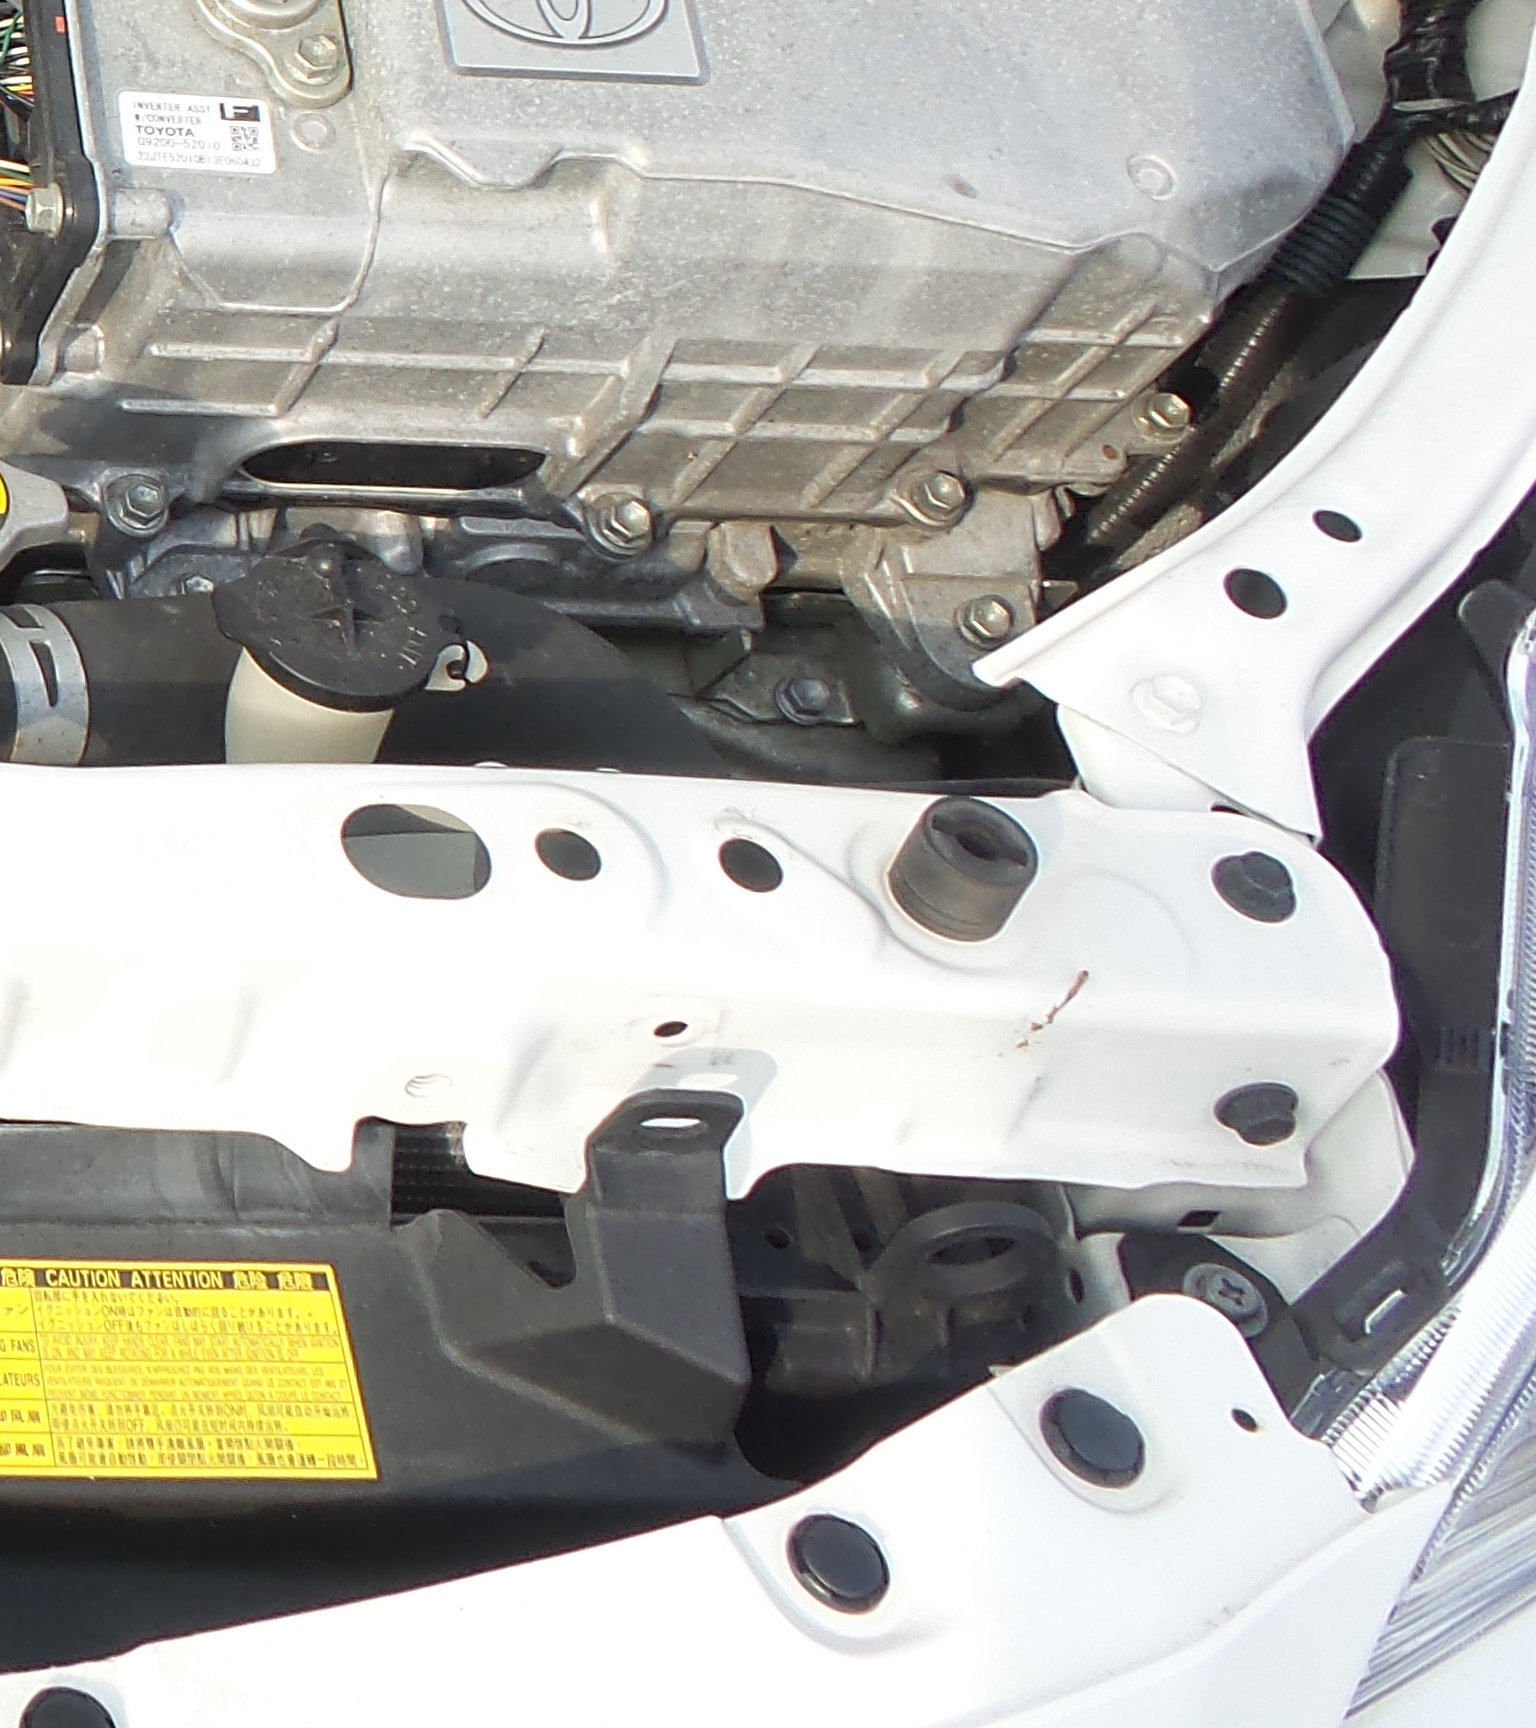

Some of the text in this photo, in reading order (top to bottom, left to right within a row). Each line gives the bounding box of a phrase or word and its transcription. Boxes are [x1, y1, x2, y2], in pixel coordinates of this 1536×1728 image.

[132, 101, 211, 114] INVERTER ASSY
[134, 125, 195, 137] TOYOTA
[44, 1269, 121, 1288] CAUTION
[131, 1270, 224, 1289] ATTENTION
[11, 1339, 37, 1354] FANS
